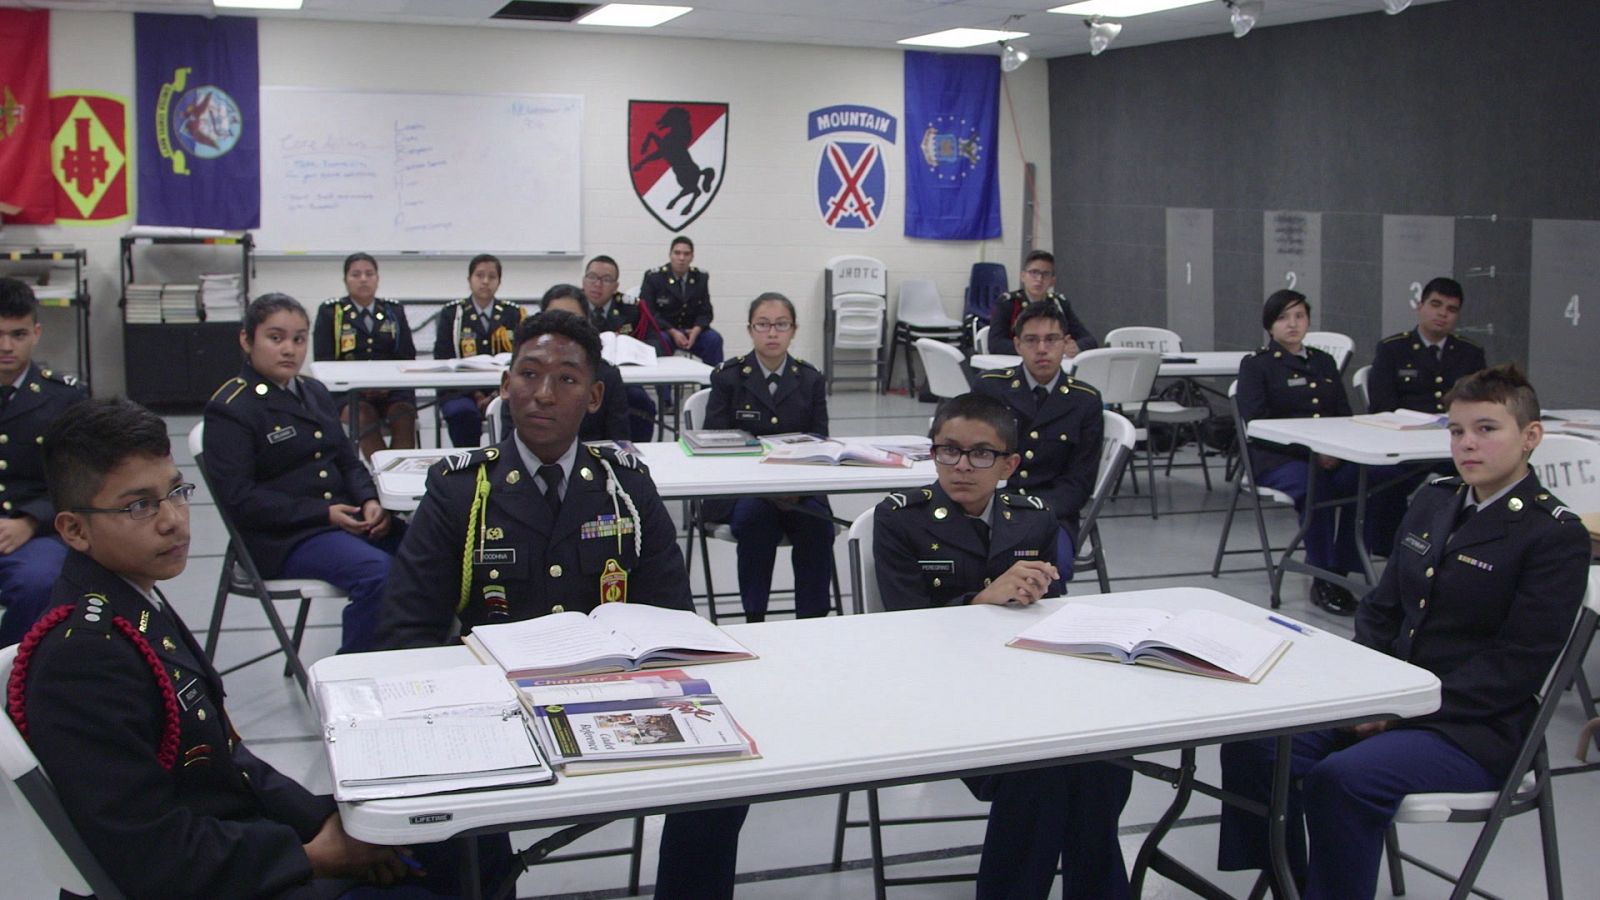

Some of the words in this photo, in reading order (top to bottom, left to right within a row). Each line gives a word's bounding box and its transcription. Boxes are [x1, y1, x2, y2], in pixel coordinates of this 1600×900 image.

[816, 111, 891, 133] MOUNTAIN
[1186, 261, 1192, 285] 1
[1286, 271, 1297, 290] 2
[1409, 282, 1423, 309] 3
[1565, 294, 1581, 326] 4
[533, 677, 608, 686] Chapter
